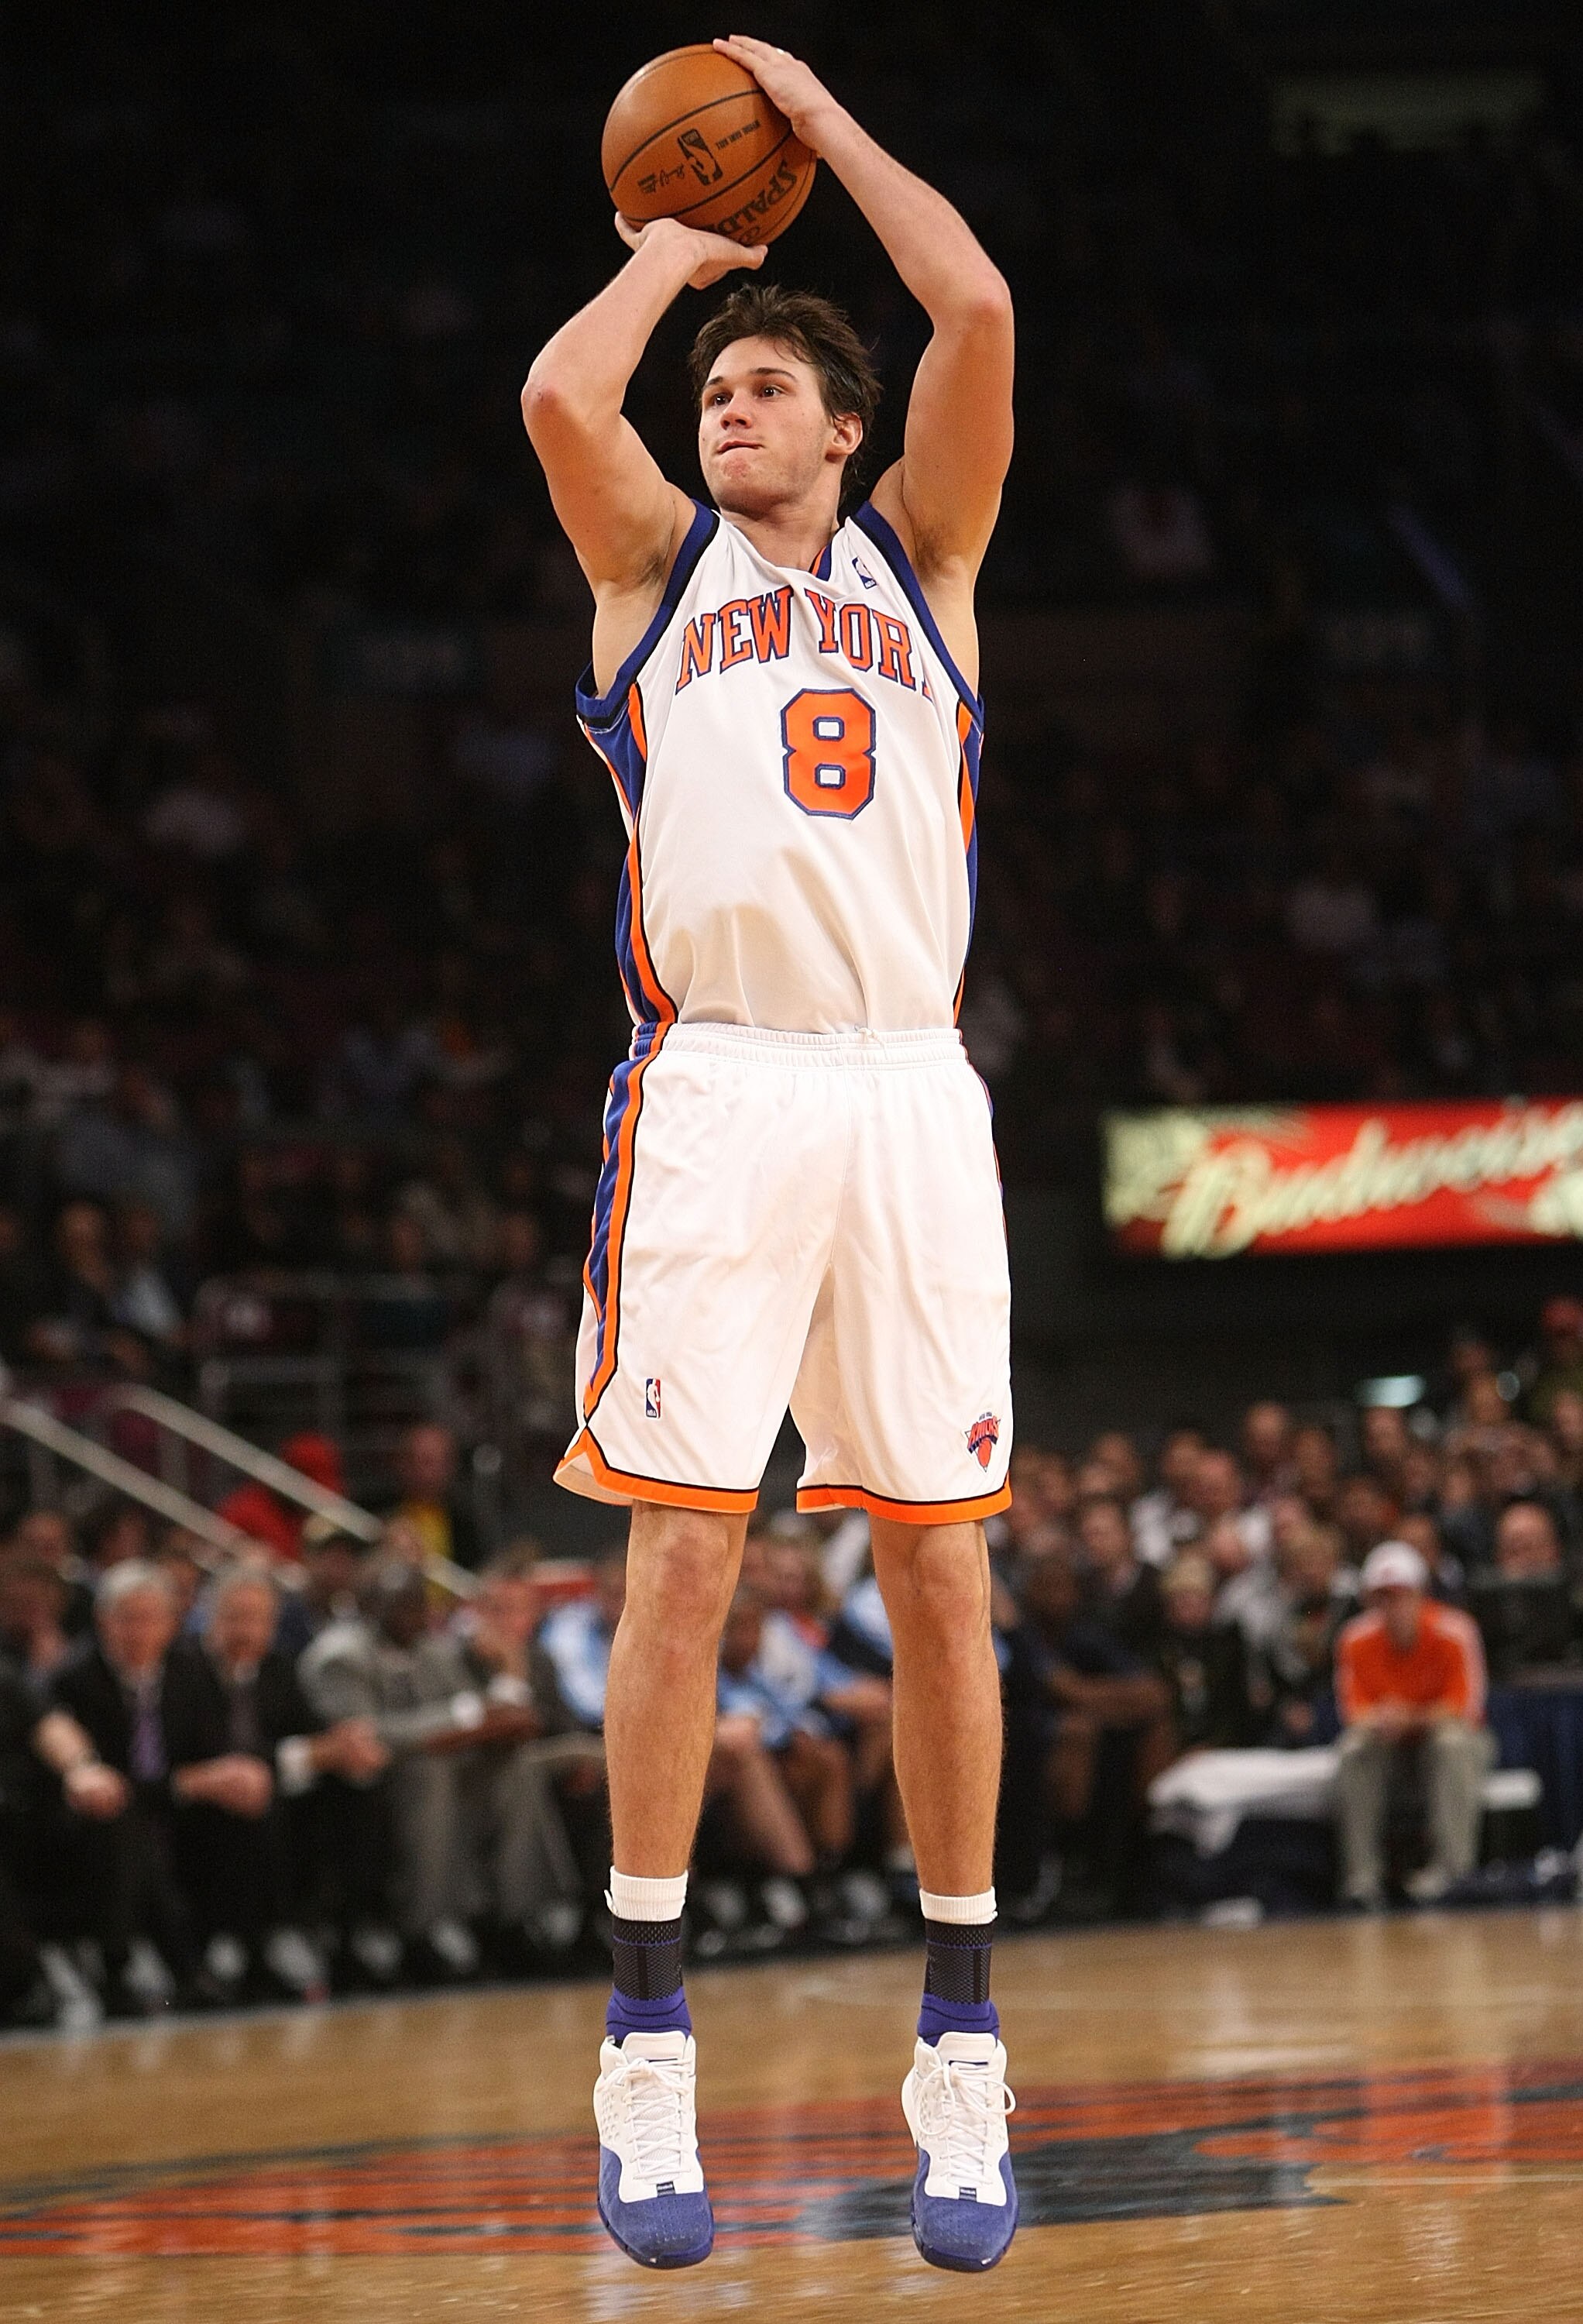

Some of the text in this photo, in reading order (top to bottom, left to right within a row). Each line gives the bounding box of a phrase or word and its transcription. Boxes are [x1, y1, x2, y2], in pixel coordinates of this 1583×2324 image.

[714, 159, 797, 235] SPALD
[675, 585, 935, 706] NEW YOR
[780, 688, 876, 820] 8
